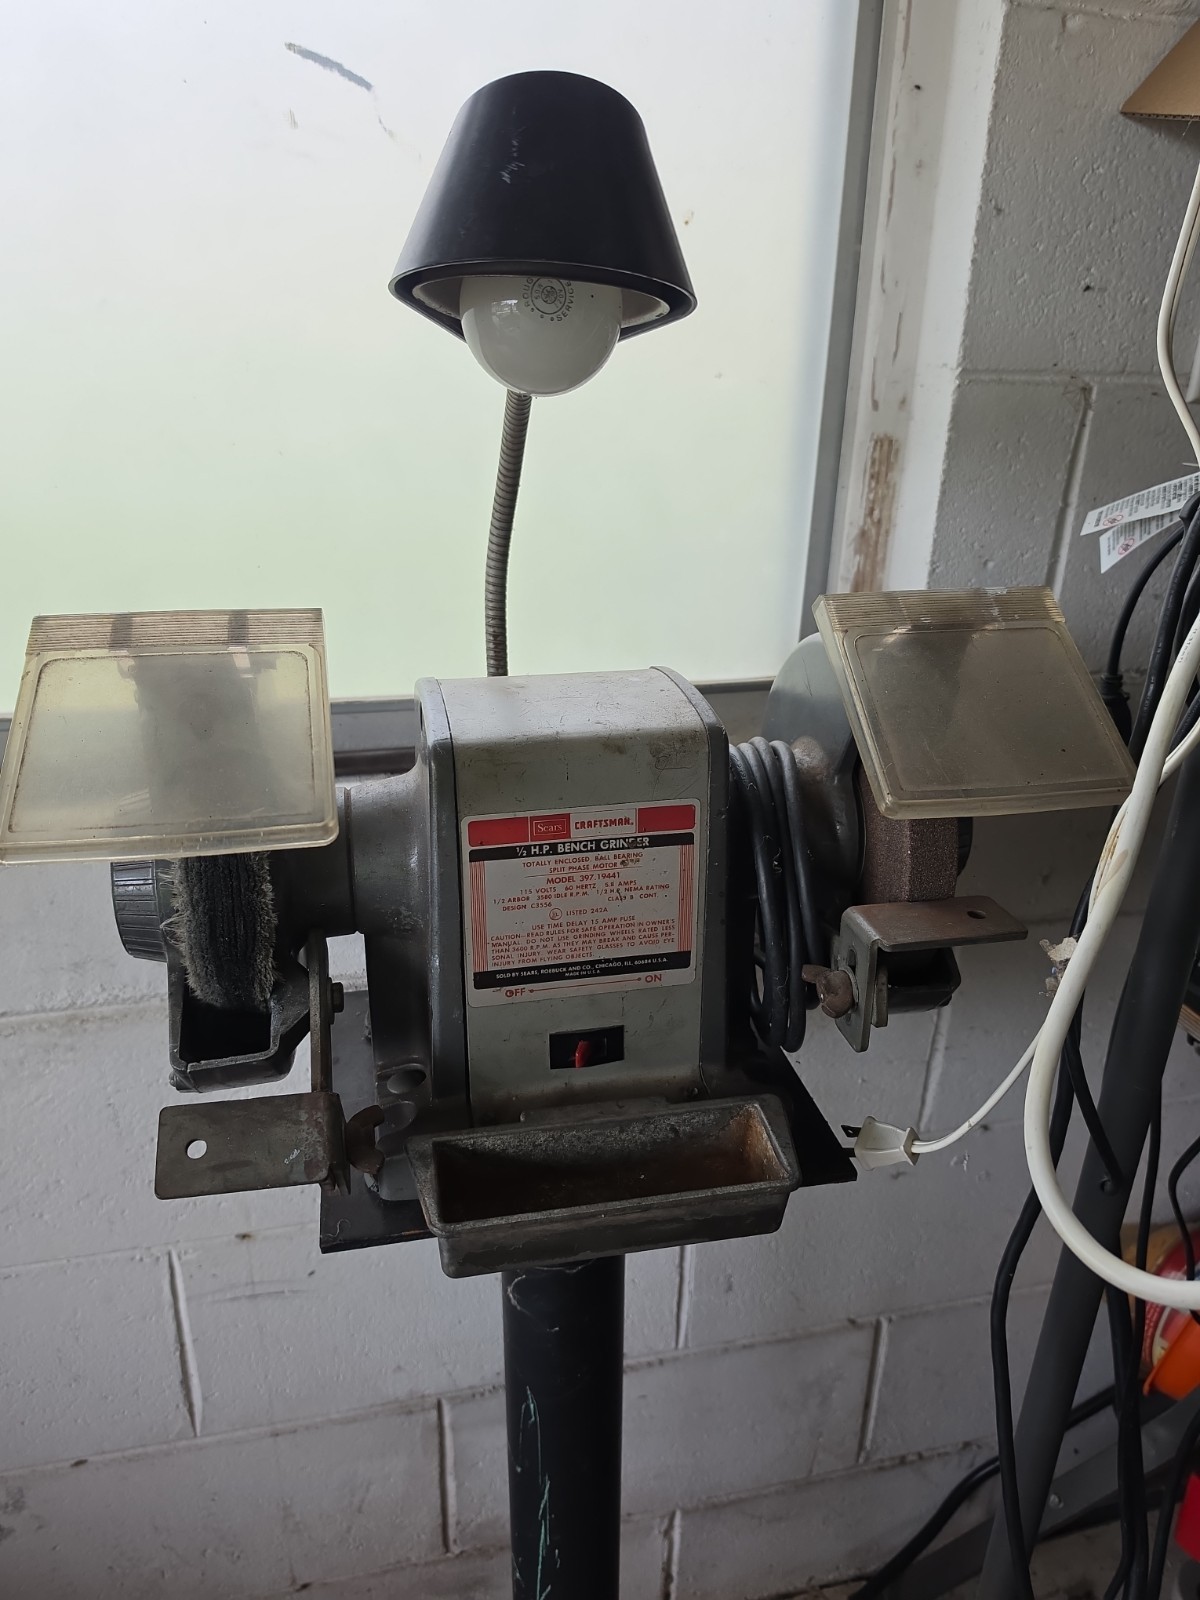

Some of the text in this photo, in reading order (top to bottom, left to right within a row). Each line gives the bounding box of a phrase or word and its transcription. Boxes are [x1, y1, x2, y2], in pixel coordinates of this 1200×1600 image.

[522, 277, 534, 307] ROUG
[556, 282, 574, 322] SERVICE
[538, 823, 562, 833] Sears
[531, 845, 553, 856] H.P.
[557, 840, 596, 853] BENCH
[555, 856, 590, 865] ENCLOSED
[546, 872, 620, 884] MODEL 397.19441
[598, 922, 635, 930] OPERATION
[645, 974, 662, 983] ON
[505, 988, 526, 998] OFF
